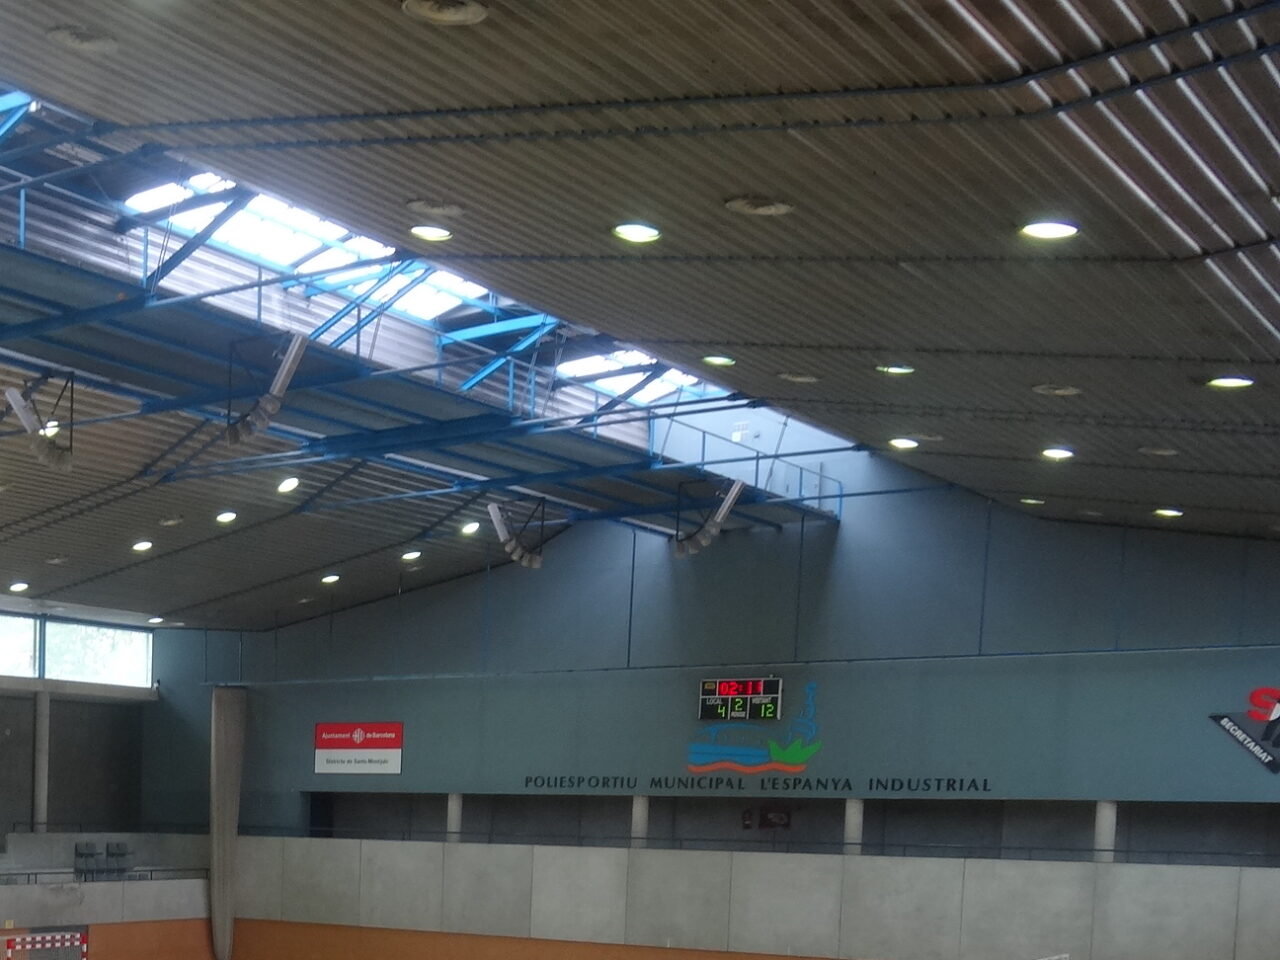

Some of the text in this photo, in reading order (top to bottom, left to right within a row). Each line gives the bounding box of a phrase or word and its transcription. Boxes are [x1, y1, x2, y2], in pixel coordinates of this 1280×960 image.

[735, 698, 743, 711] 2
[761, 704, 775, 718] 12
[717, 705, 726, 718] 4
[322, 732, 351, 740] Ajuntament
[524, 775, 992, 792] POLIESPORTIU MUNICIPAL L'ESPANYA INDUSTRIAL
